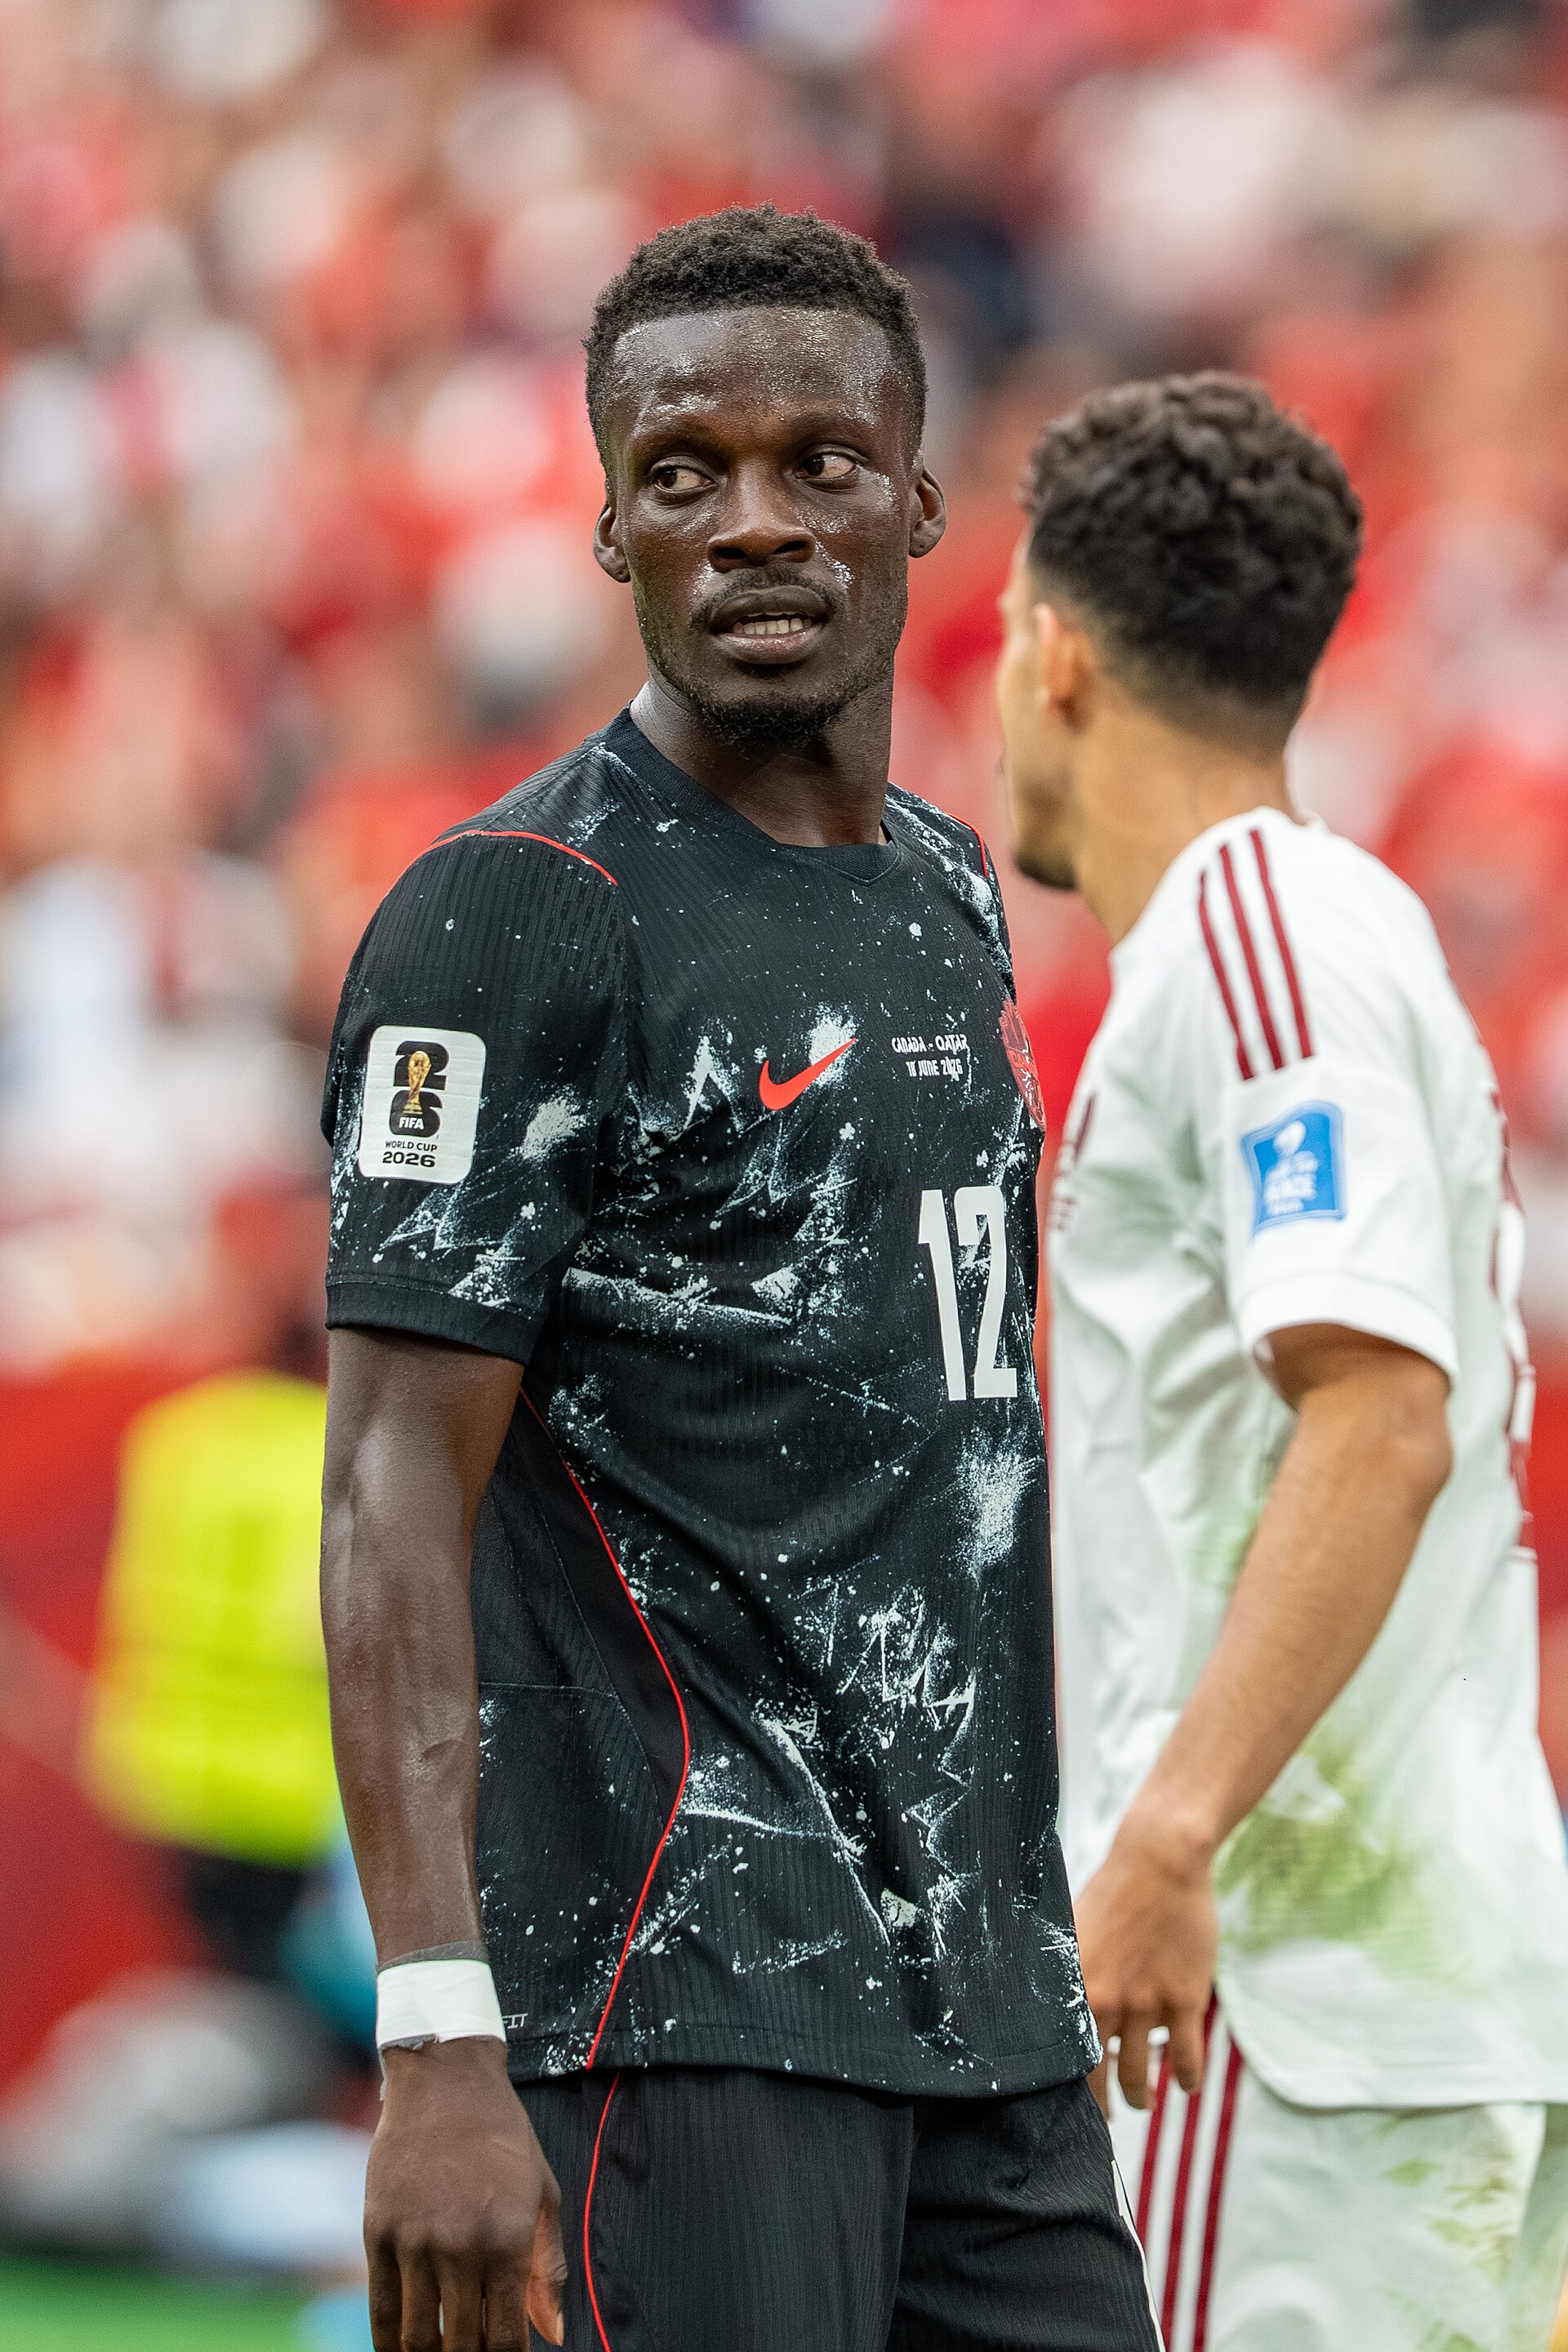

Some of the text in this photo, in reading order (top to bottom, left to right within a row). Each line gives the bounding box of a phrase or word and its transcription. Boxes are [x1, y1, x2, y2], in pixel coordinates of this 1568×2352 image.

[891, 1036, 927, 1053] CANADA
[935, 1033, 969, 1051] QATAR
[918, 1059, 940, 1077] JUNE
[940, 1058, 964, 1076] 2026
[399, 1116, 425, 1130] FIFA
[385, 1140, 438, 1152] WORLD CUP
[382, 1151, 436, 1168] 2026
[918, 1186, 1018, 1401] 12
